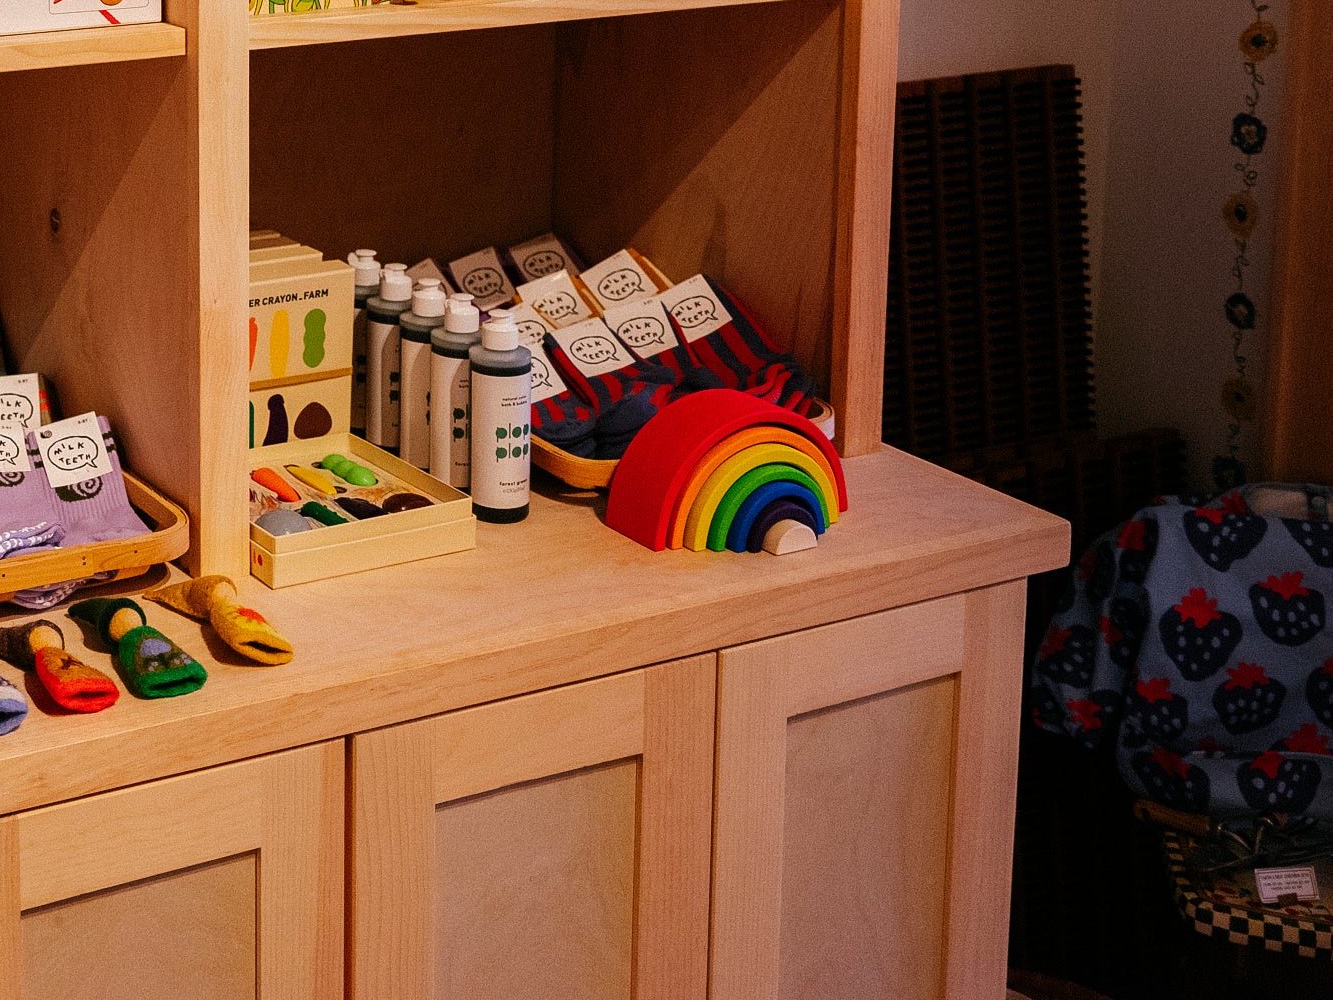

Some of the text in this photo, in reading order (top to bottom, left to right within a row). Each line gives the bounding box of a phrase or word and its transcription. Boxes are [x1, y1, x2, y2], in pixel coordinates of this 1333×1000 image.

[603, 274, 627, 290] MILK
[610, 281, 636, 296] TEETH
[538, 297, 563, 309] MILK
[675, 301, 701, 317] MILK
[545, 305, 571, 316] TEETH
[681, 309, 710, 324] TEETH
[623, 322, 651, 334] MILK
[628, 332, 658, 343] TEETH
[576, 341, 602, 352] MILK
[583, 350, 611, 360] TEETH
[495, 422, 529, 443] plop
[54, 442, 85, 455] MILK
[495, 443, 529, 463] plop
[59, 454, 91, 465] TEETH
